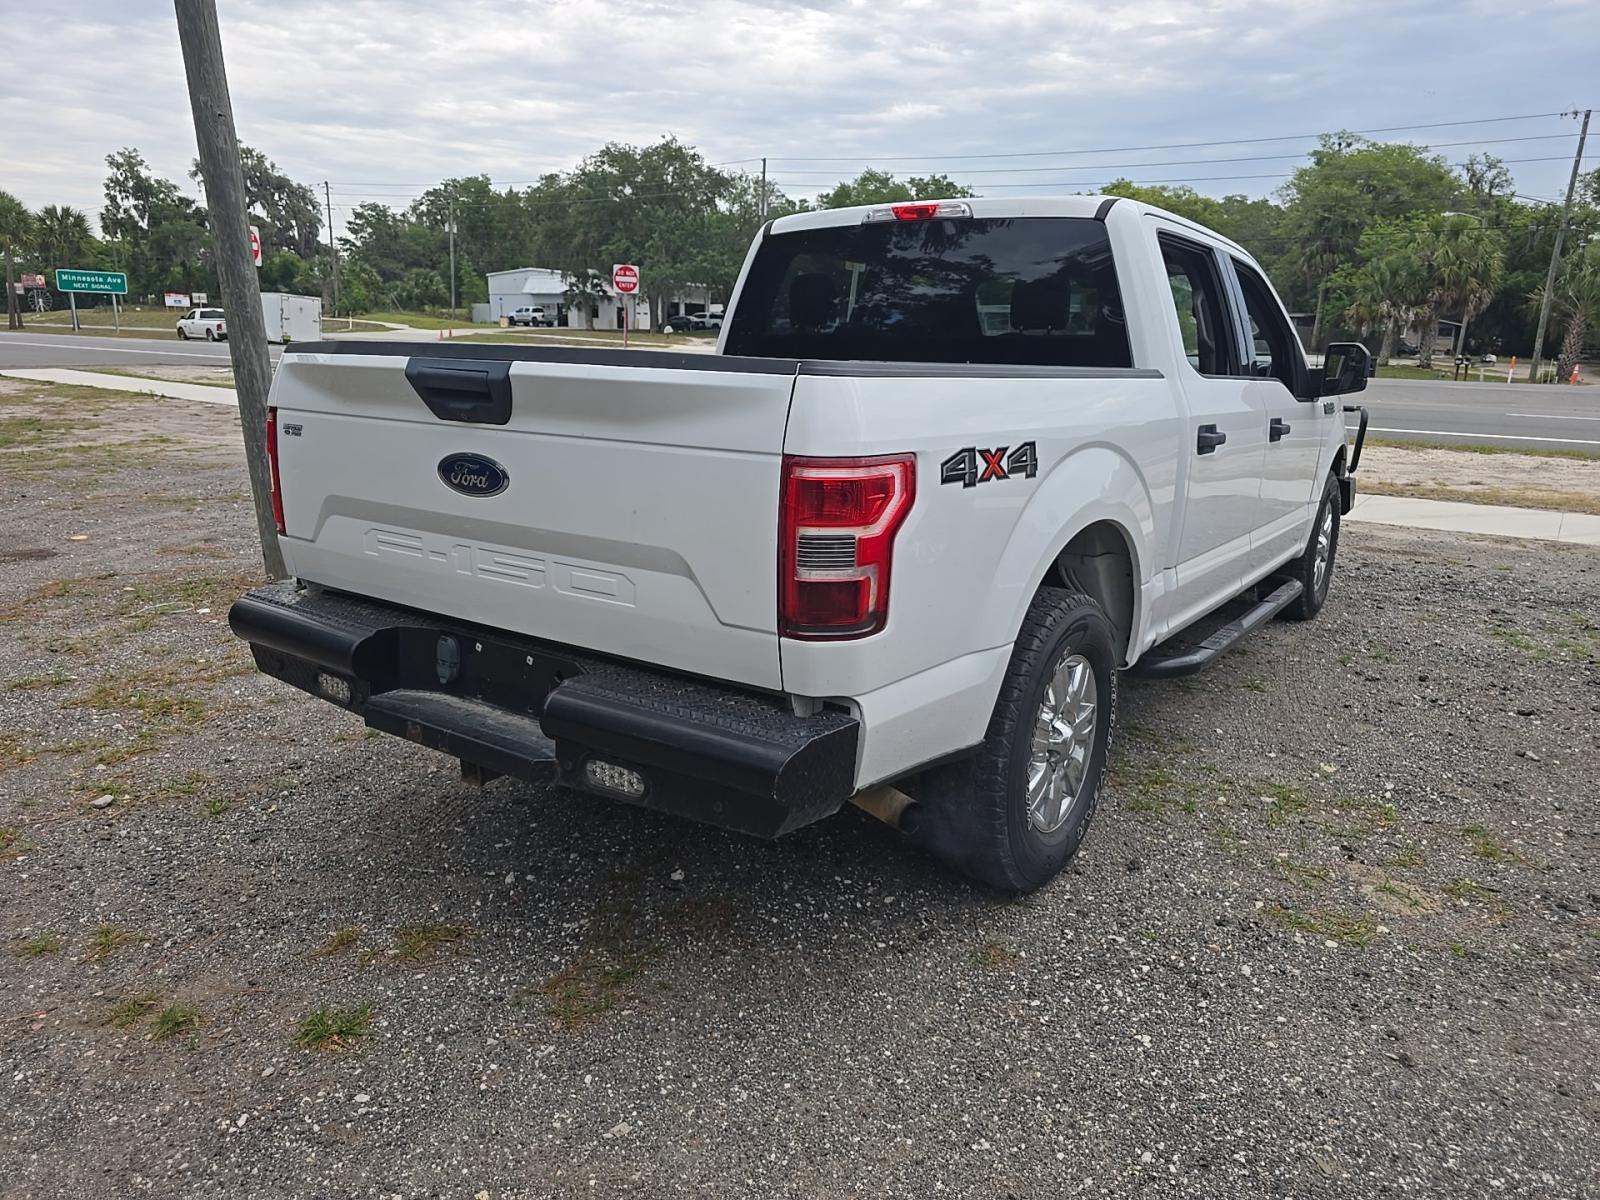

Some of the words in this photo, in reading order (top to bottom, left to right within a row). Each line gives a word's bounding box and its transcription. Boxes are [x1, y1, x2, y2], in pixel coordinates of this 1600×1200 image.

[61, 274, 104, 283] Minnesota
[107, 276, 122, 284] Ave
[450, 461, 489, 488] Ford
[363, 528, 636, 608] F-150
